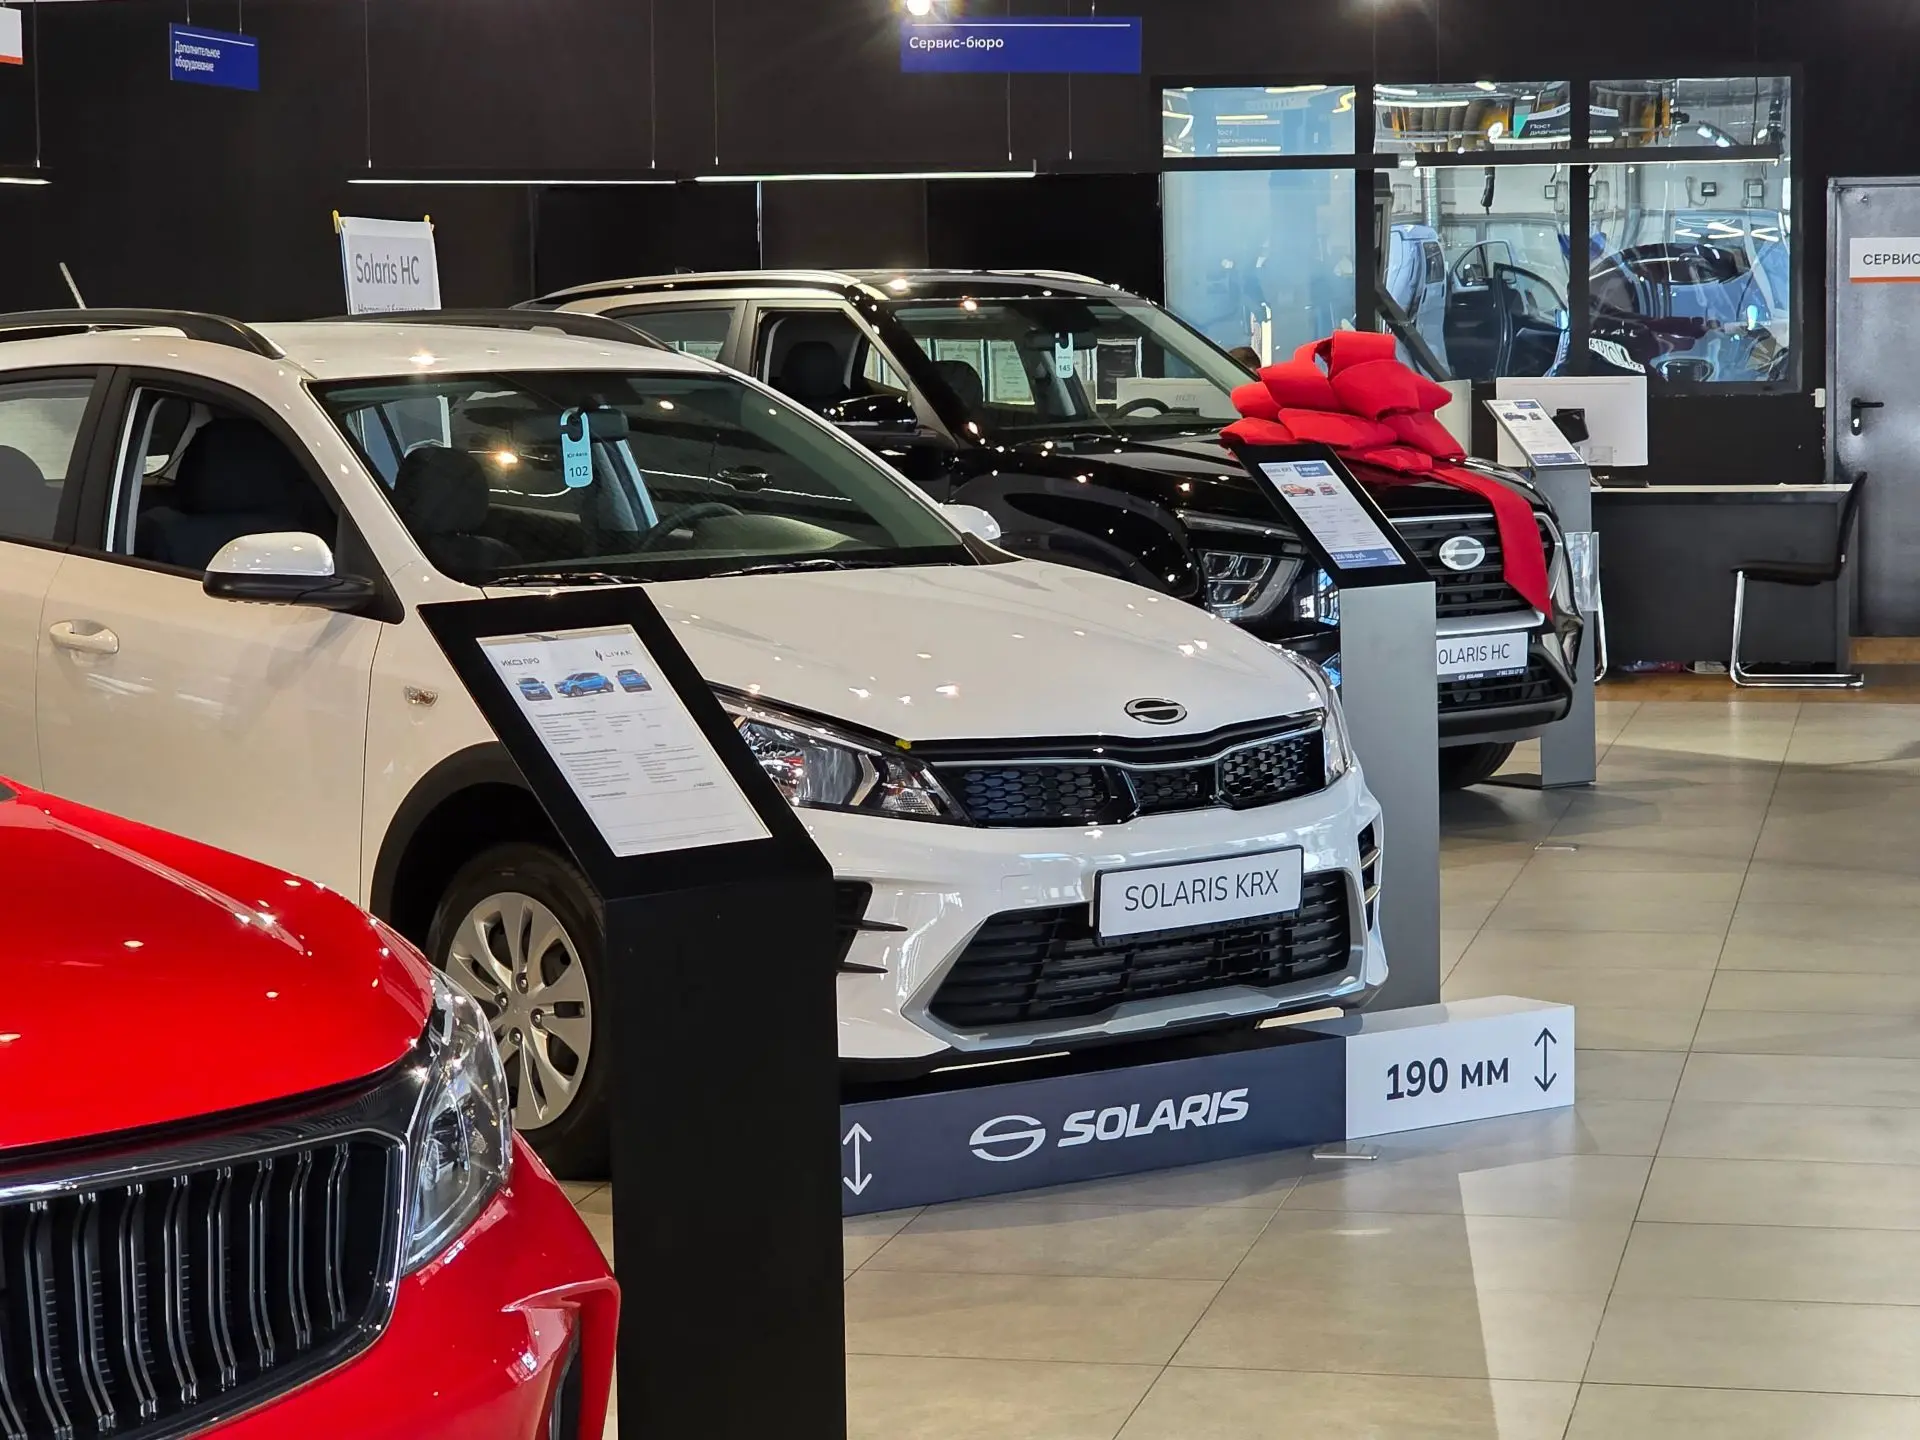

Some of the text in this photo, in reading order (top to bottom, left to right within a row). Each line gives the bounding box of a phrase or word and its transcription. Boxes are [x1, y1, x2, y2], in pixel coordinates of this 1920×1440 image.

[908, 36, 1004, 51] Сервис-бюро
[355, 252, 420, 285] Solaris HC
[1862, 252, 1920, 266] СЕРВИС
[1058, 364, 1071, 372] 145
[568, 465, 589, 478] 102
[1438, 645, 1488, 665] OLARIS
[1124, 868, 1280, 912] SOLARIS KRX
[1386, 1057, 1449, 1101] 190
[1057, 1087, 1250, 1148] SOLARIS
